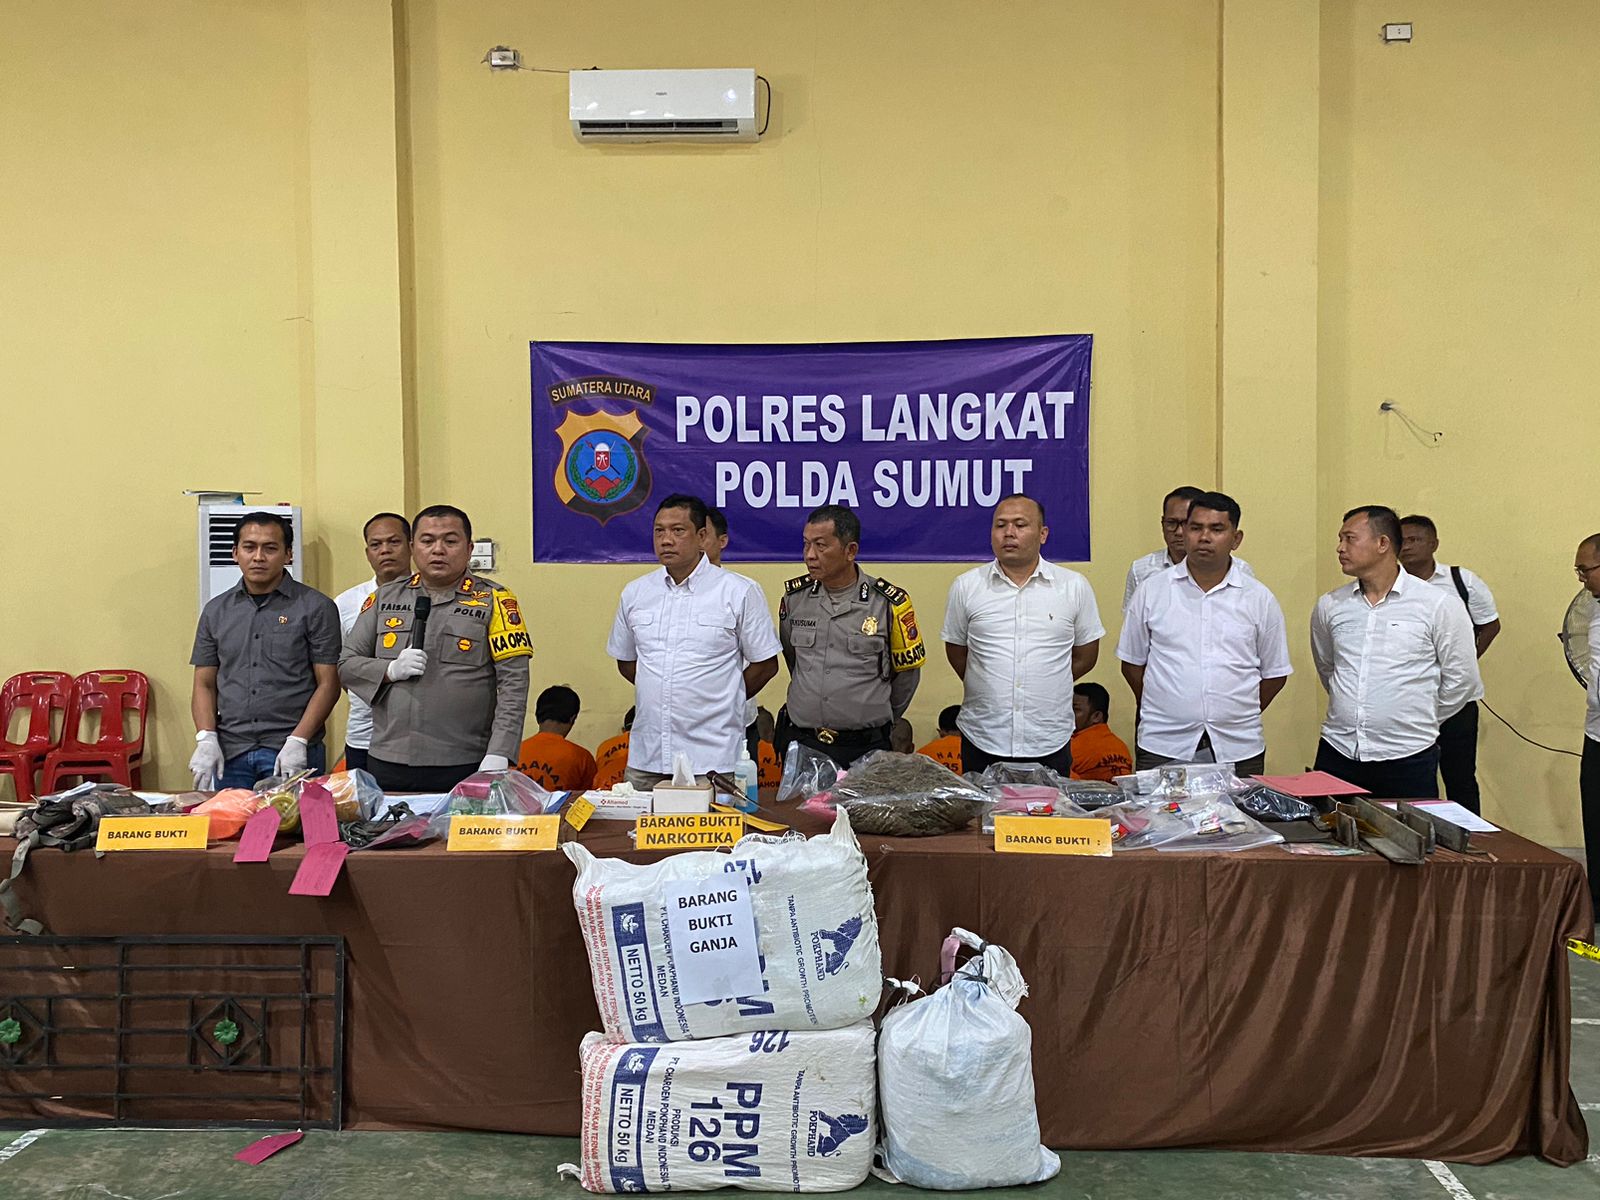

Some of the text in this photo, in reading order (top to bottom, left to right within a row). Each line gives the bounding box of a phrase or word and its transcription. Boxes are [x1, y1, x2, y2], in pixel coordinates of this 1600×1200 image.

[551, 381, 651, 402] SUMATERA UTARA
[676, 391, 1075, 443] POLRES LANGKAT
[716, 458, 1034, 508] POLDA SUMUT
[380, 603, 412, 611] FAISAL
[454, 608, 486, 619] POLRI
[107, 830, 188, 839] BARANG BUKTI
[459, 827, 538, 835] BARANG BUKTI
[640, 816, 741, 828] BARANG BUKTI
[646, 832, 734, 845] NARKOTIKA
[1005, 835, 1052, 844] BARANG
[1055, 836, 1090, 845] BUKTI
[678, 890, 738, 909] BARANG
[787, 895, 796, 918] TANPA
[599, 921, 608, 948] KHUSUS
[688, 914, 733, 931] BUKTI
[690, 936, 738, 953] GANJA
[789, 918, 803, 955] ANTIBIOTIC
[602, 949, 612, 973] UNTUK
[810, 930, 825, 981] POKPHAND
[605, 973, 616, 996] PAKAN
[626, 948, 648, 1021] NETTO 50 kg
[656, 965, 669, 998] MEDAN
[797, 956, 807, 989] GROWTH
[749, 1030, 790, 1053] 126
[594, 1081, 603, 1105] UNTUK
[661, 1067, 675, 1101] CHAROEN
[794, 1070, 805, 1090] TANPA
[584, 1094, 592, 1120] BUKAN
[591, 1106, 600, 1131] PAKAN
[791, 1091, 800, 1128] ANTIBIOTIC
[615, 1088, 634, 1163] NETTO 50 kg
[645, 1110, 656, 1144] MEDAN
[658, 1102, 669, 1143] POKPHAND
[670, 1108, 681, 1147] PRODUKSI
[687, 1097, 723, 1162] 126
[722, 1082, 763, 1177] PPM
[807, 1110, 818, 1157] POKPHAND
[790, 1129, 798, 1159] GROWTH
